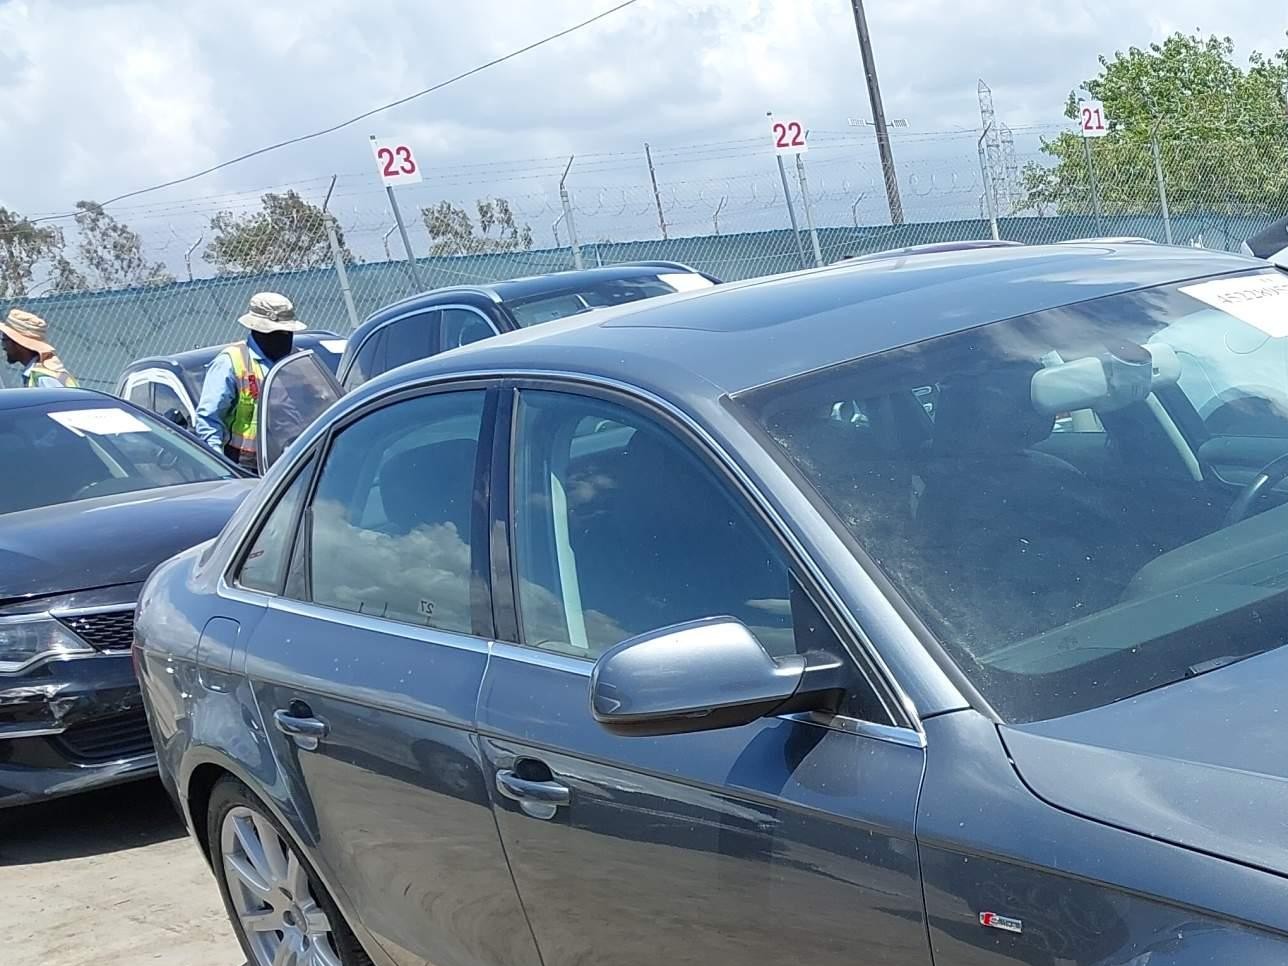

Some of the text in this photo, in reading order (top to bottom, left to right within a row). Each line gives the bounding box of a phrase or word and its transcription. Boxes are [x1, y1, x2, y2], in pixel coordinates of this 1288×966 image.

[1082, 108, 1105, 130] 21
[773, 122, 805, 148] 22
[377, 146, 416, 177] 23
